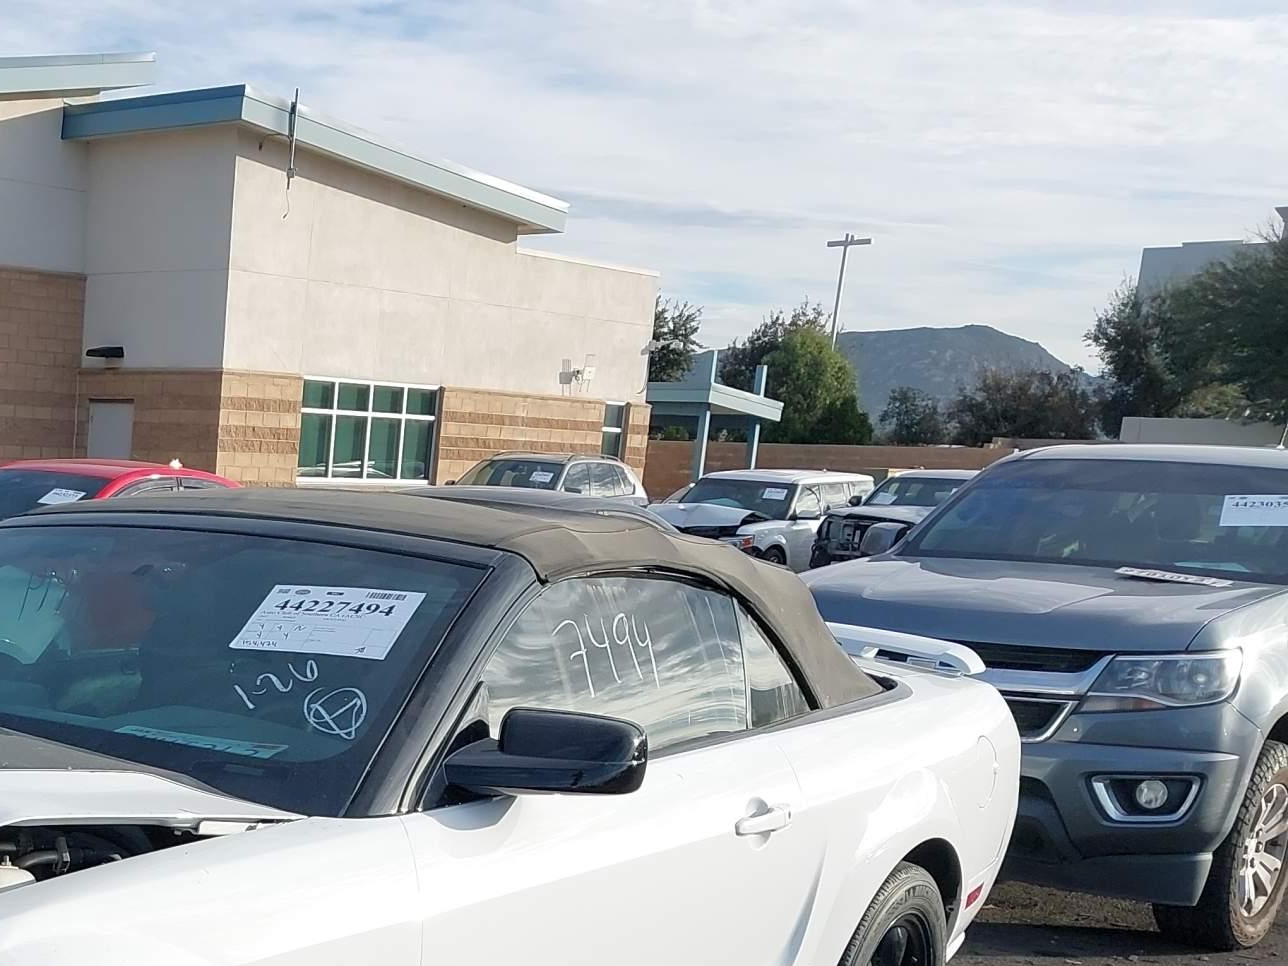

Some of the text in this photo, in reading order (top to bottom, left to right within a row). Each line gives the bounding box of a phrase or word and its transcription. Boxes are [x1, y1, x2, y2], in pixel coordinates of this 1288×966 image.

[274, 599, 396, 617] 44227494
[551, 612, 661, 698] 7494
[233, 660, 319, 710] 1-26
